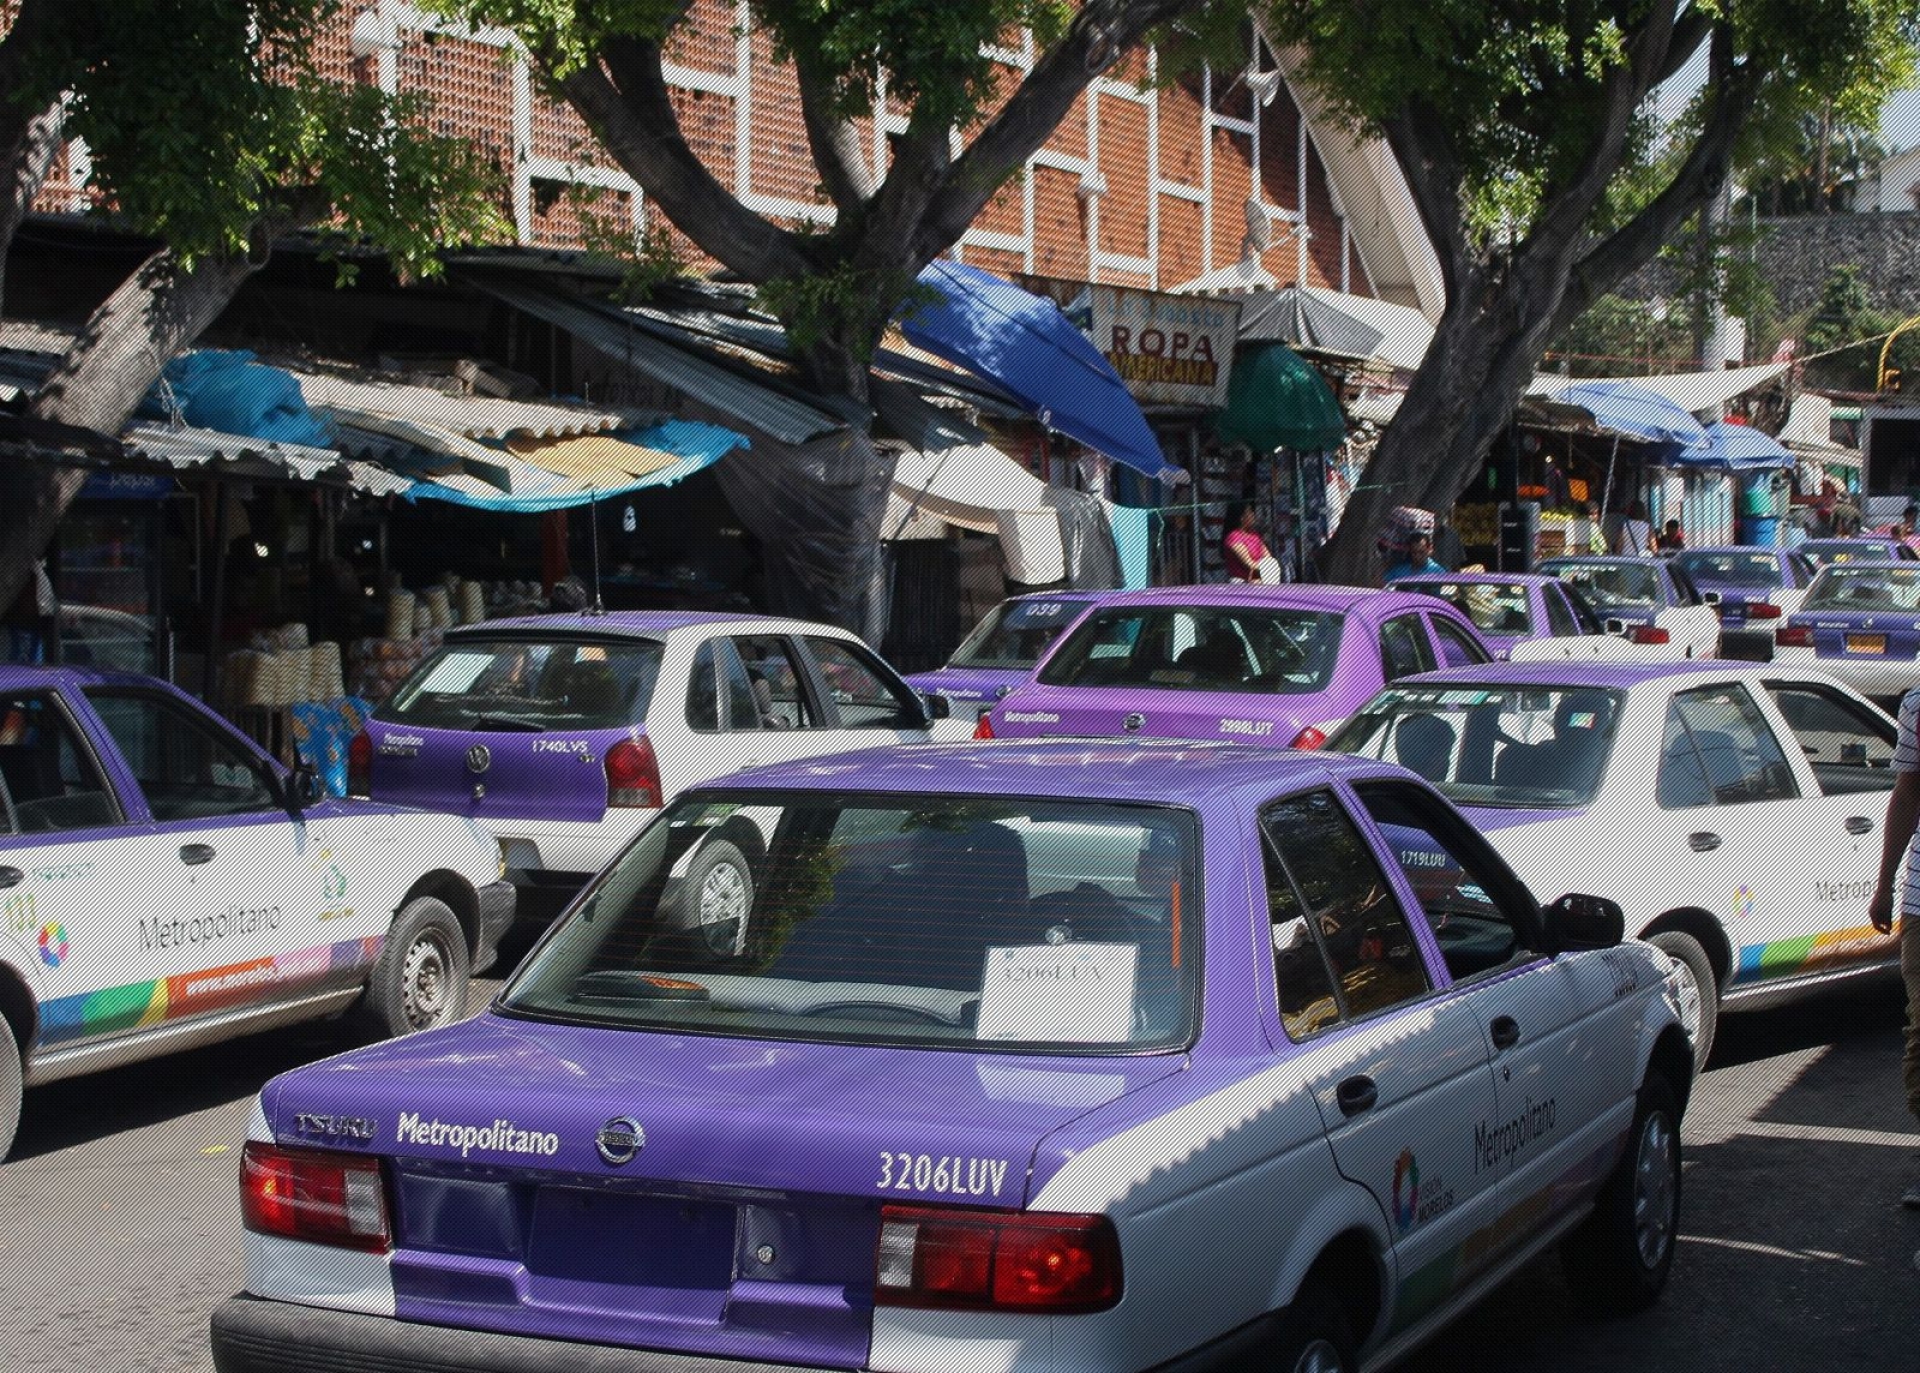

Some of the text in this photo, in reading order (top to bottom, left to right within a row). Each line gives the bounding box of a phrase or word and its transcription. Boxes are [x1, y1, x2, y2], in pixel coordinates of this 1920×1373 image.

[1112, 325, 1214, 363] ROPA
[1026, 603, 1062, 617] 039
[1004, 711, 1060, 725] Metropolitano
[533, 740, 588, 754] 1740LVS
[5, 893, 36, 933] 133
[139, 905, 281, 951] Metropolitano
[295, 1112, 378, 1139] TSURU
[396, 1111, 558, 1157] Metropolitano
[1474, 1096, 1556, 1175] Metropolitano
[876, 1151, 1008, 1197] 3206LUV
